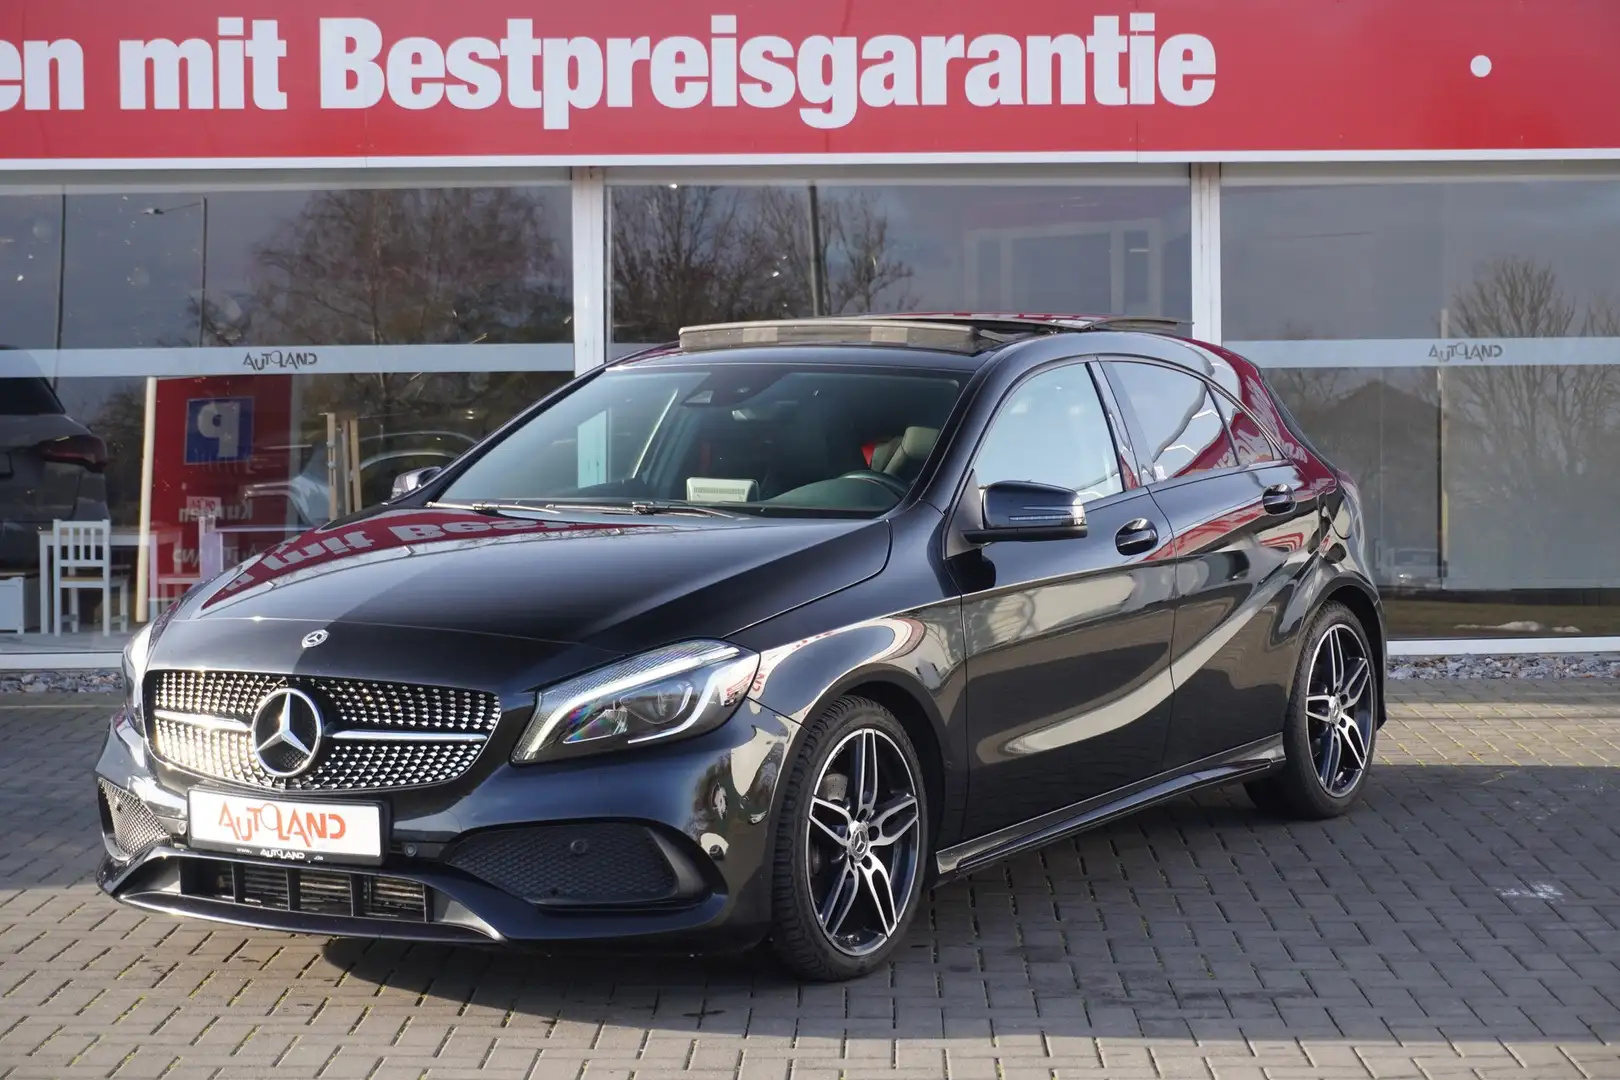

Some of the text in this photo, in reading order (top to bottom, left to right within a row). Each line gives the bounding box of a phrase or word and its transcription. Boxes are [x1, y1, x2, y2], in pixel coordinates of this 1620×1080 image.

[120, 17, 287, 110] mit
[320, 13, 1217, 129] Bestpreisgarantie
[243, 350, 318, 371] AUTOLAND
[1428, 342, 1504, 363] AUTOLAND
[218, 801, 347, 848] AUTOLAND
